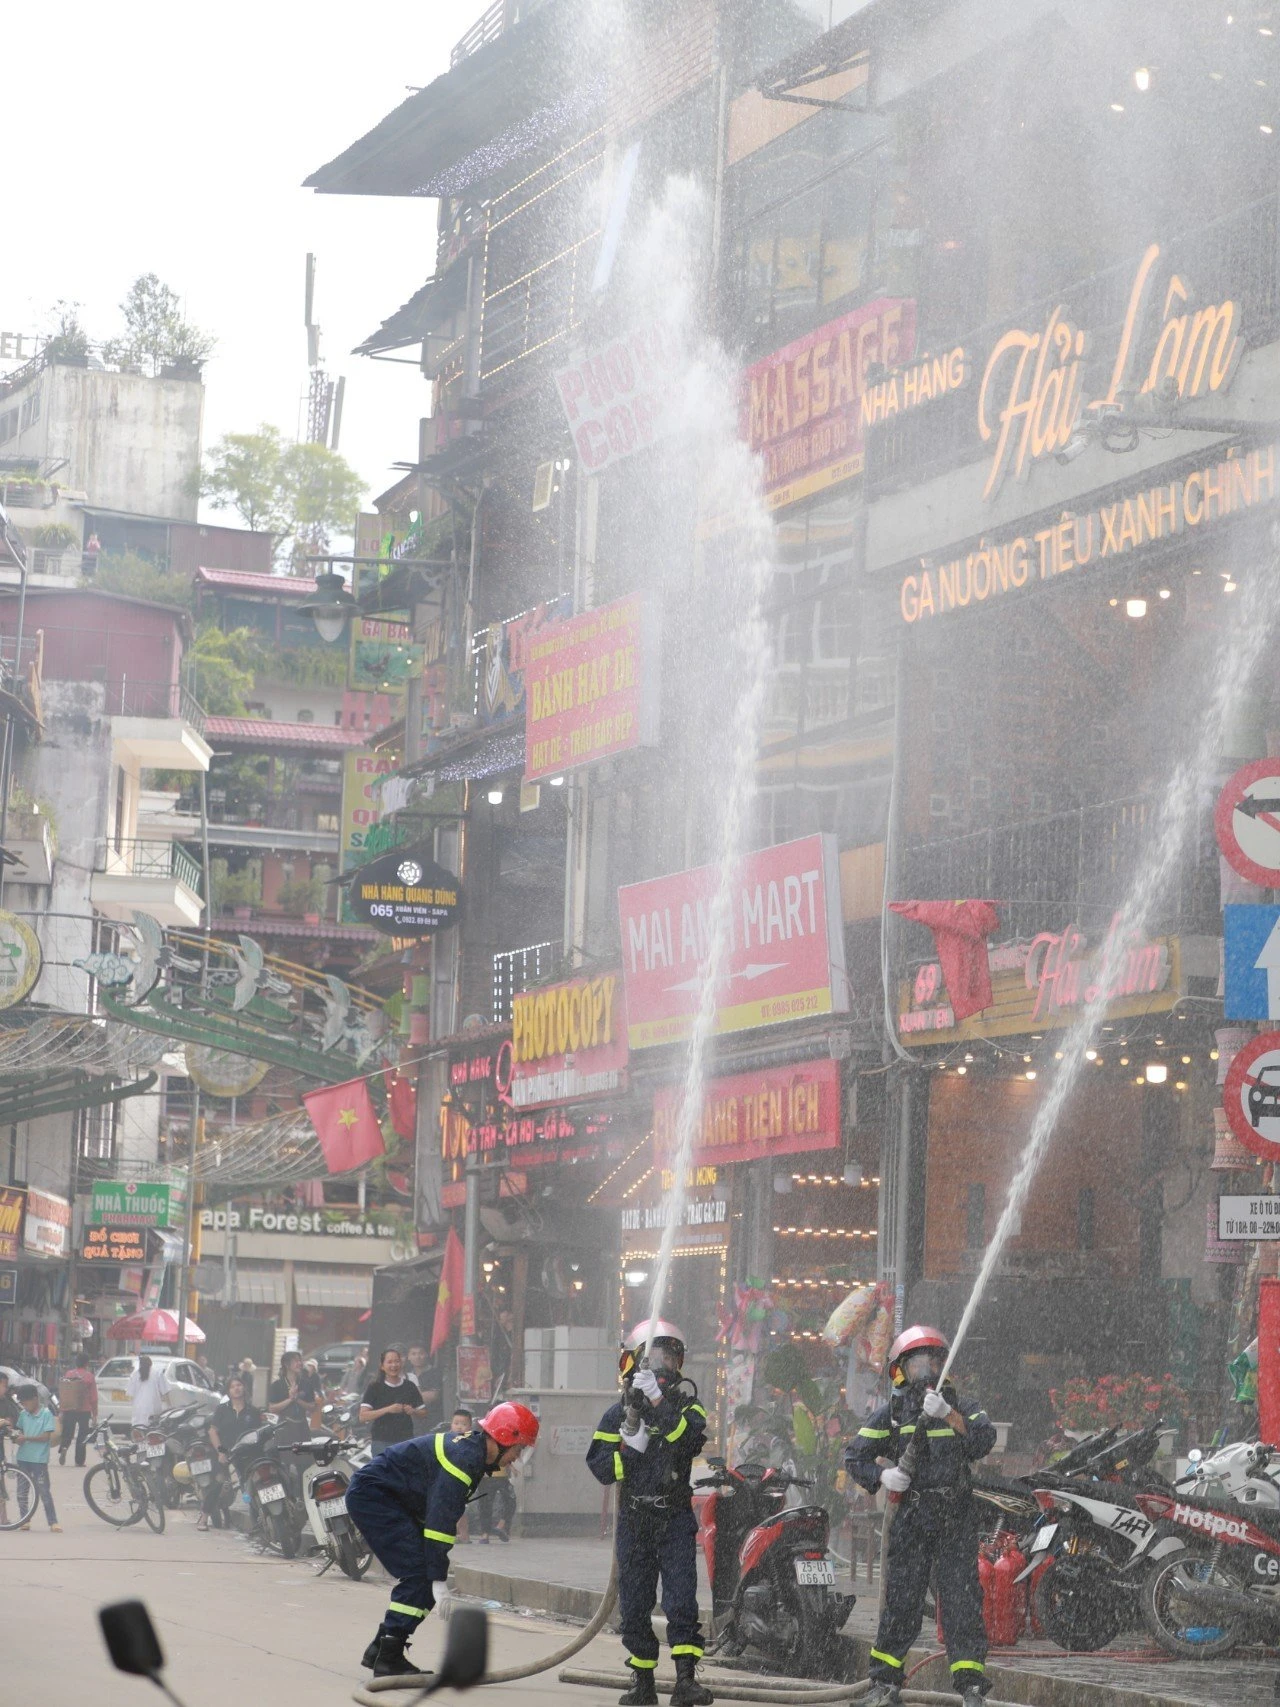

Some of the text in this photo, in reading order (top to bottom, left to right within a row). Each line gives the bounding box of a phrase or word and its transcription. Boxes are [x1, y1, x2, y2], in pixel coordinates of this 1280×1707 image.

[903, 347, 964, 411] HÀNG
[978, 243, 1238, 502] Hải Lâm
[900, 558, 935, 623] GÀ
[938, 537, 1029, 614] NƯỚNG
[1035, 512, 1094, 580] TIÊU
[1100, 482, 1177, 557] XANH
[531, 663, 574, 723] BÁNH
[361, 882, 379, 900] NHÀ
[380, 882, 404, 902] HÀNG
[406, 887, 433, 904] QUANG
[370, 904, 393, 917] 065
[432, 908, 448, 917] SAPA
[628, 907, 674, 974] MAI
[742, 869, 819, 949] MART
[513, 976, 616, 1064] PHOTOCOPY
[125, 1191, 167, 1214] THUỐC
[1250, 1202, 1258, 1215] XE
[200, 1208, 240, 1231] apa
[250, 1208, 322, 1232] Forest
[326, 1221, 362, 1236] coffee
[365, 1223, 375, 1236] &
[1173, 1504, 1250, 1540] Hotpot
[801, 1573, 833, 1584] 066.10
[802, 1562, 828, 1573] 25-U1
